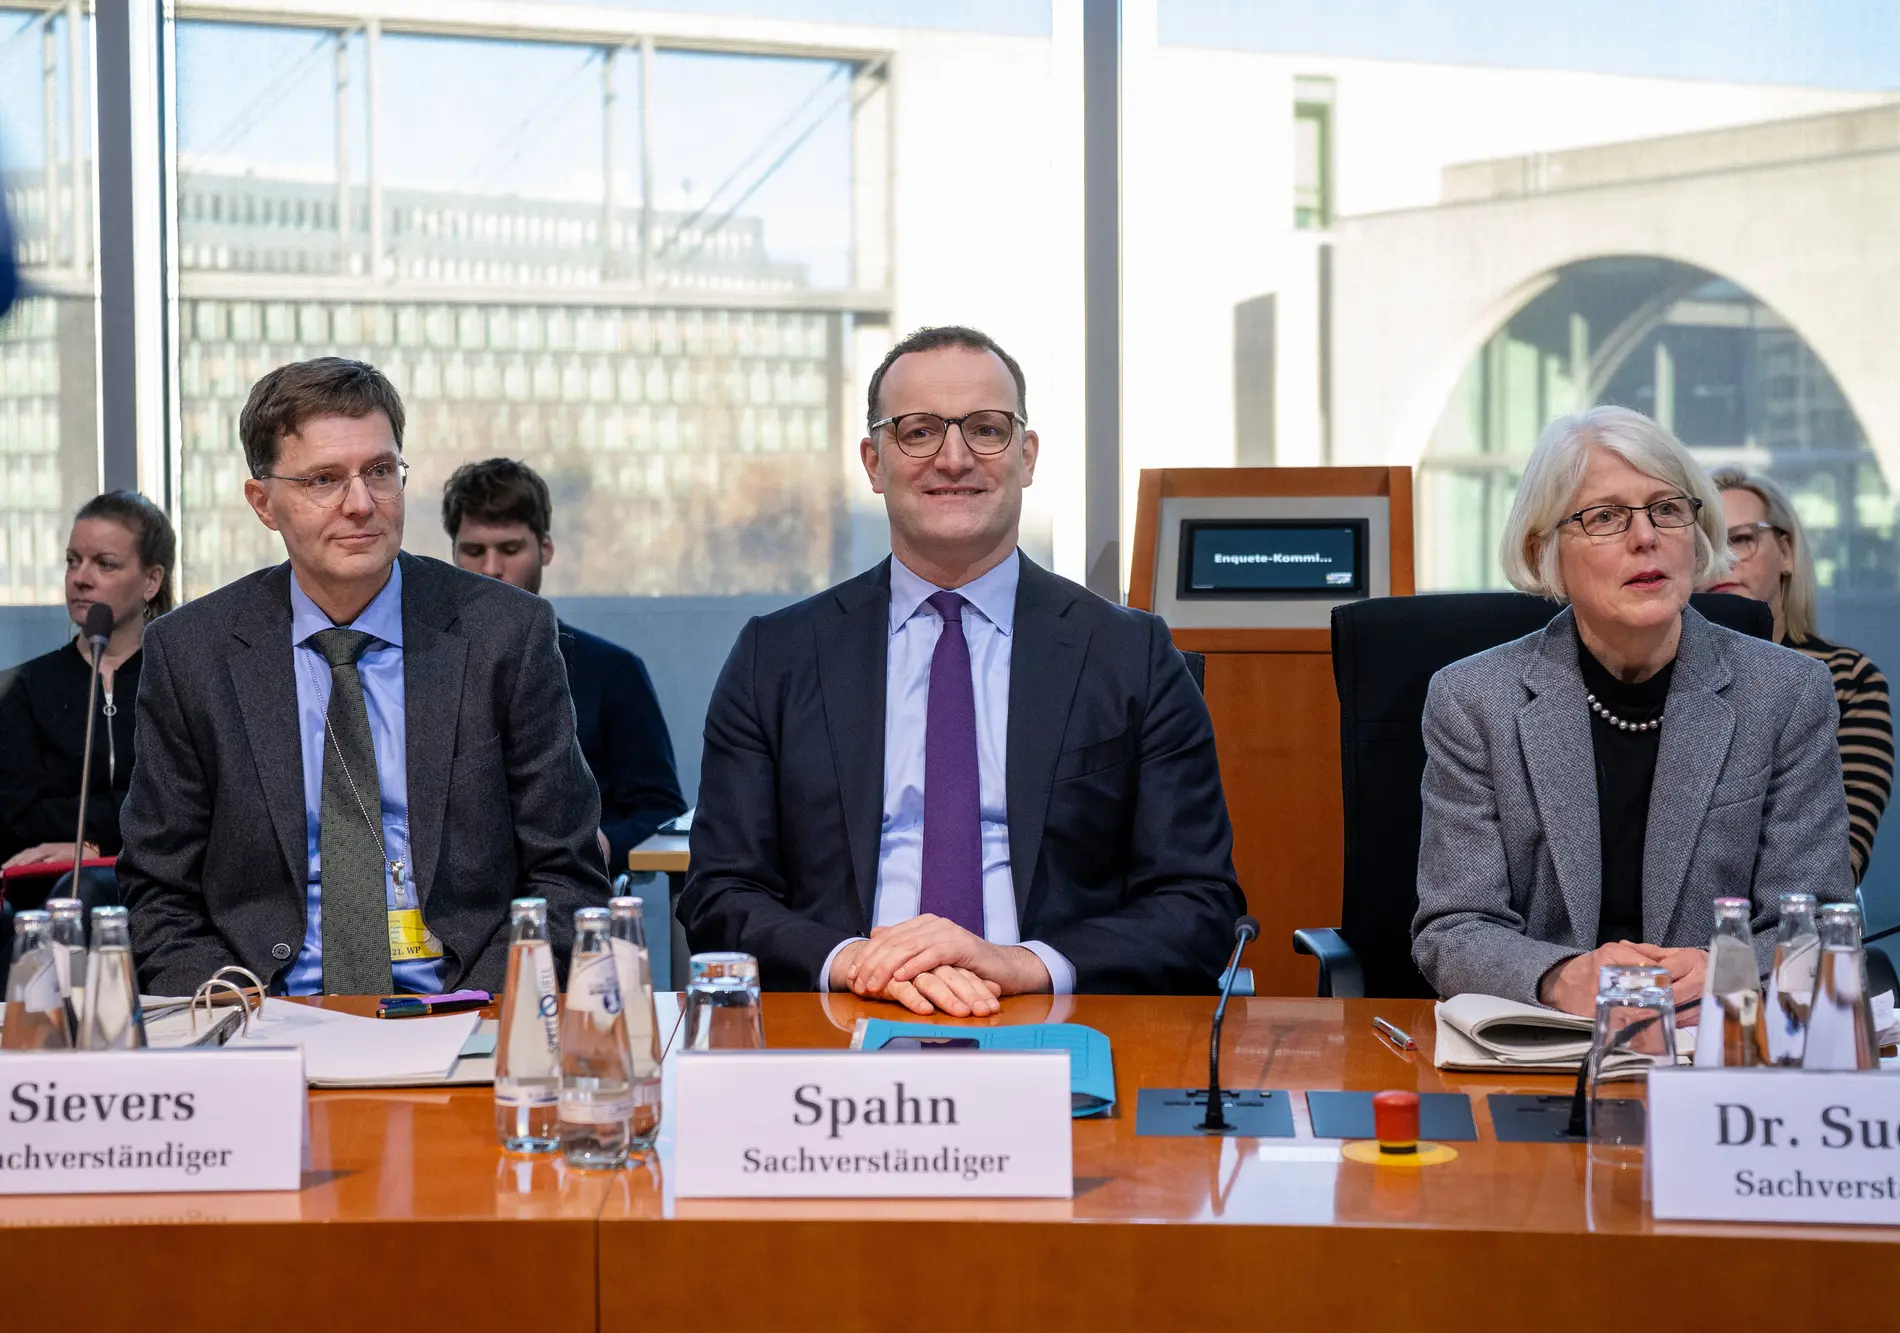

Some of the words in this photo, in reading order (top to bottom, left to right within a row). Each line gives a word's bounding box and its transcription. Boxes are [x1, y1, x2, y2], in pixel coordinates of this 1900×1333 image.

[1213, 552, 1333, 566] Enquete-Kommi...
[392, 948, 405, 956] 21.
[406, 946, 421, 955] WP
[9, 1081, 196, 1124] Sievers
[793, 1082, 958, 1139] Spahn
[1716, 1103, 1800, 1147] Dr.
[1821, 1105, 1900, 1150] Su
[0, 1142, 233, 1174] chverständiger
[743, 1147, 1010, 1179] Sachverständiger
[1735, 1169, 1900, 1200] Sachverst
